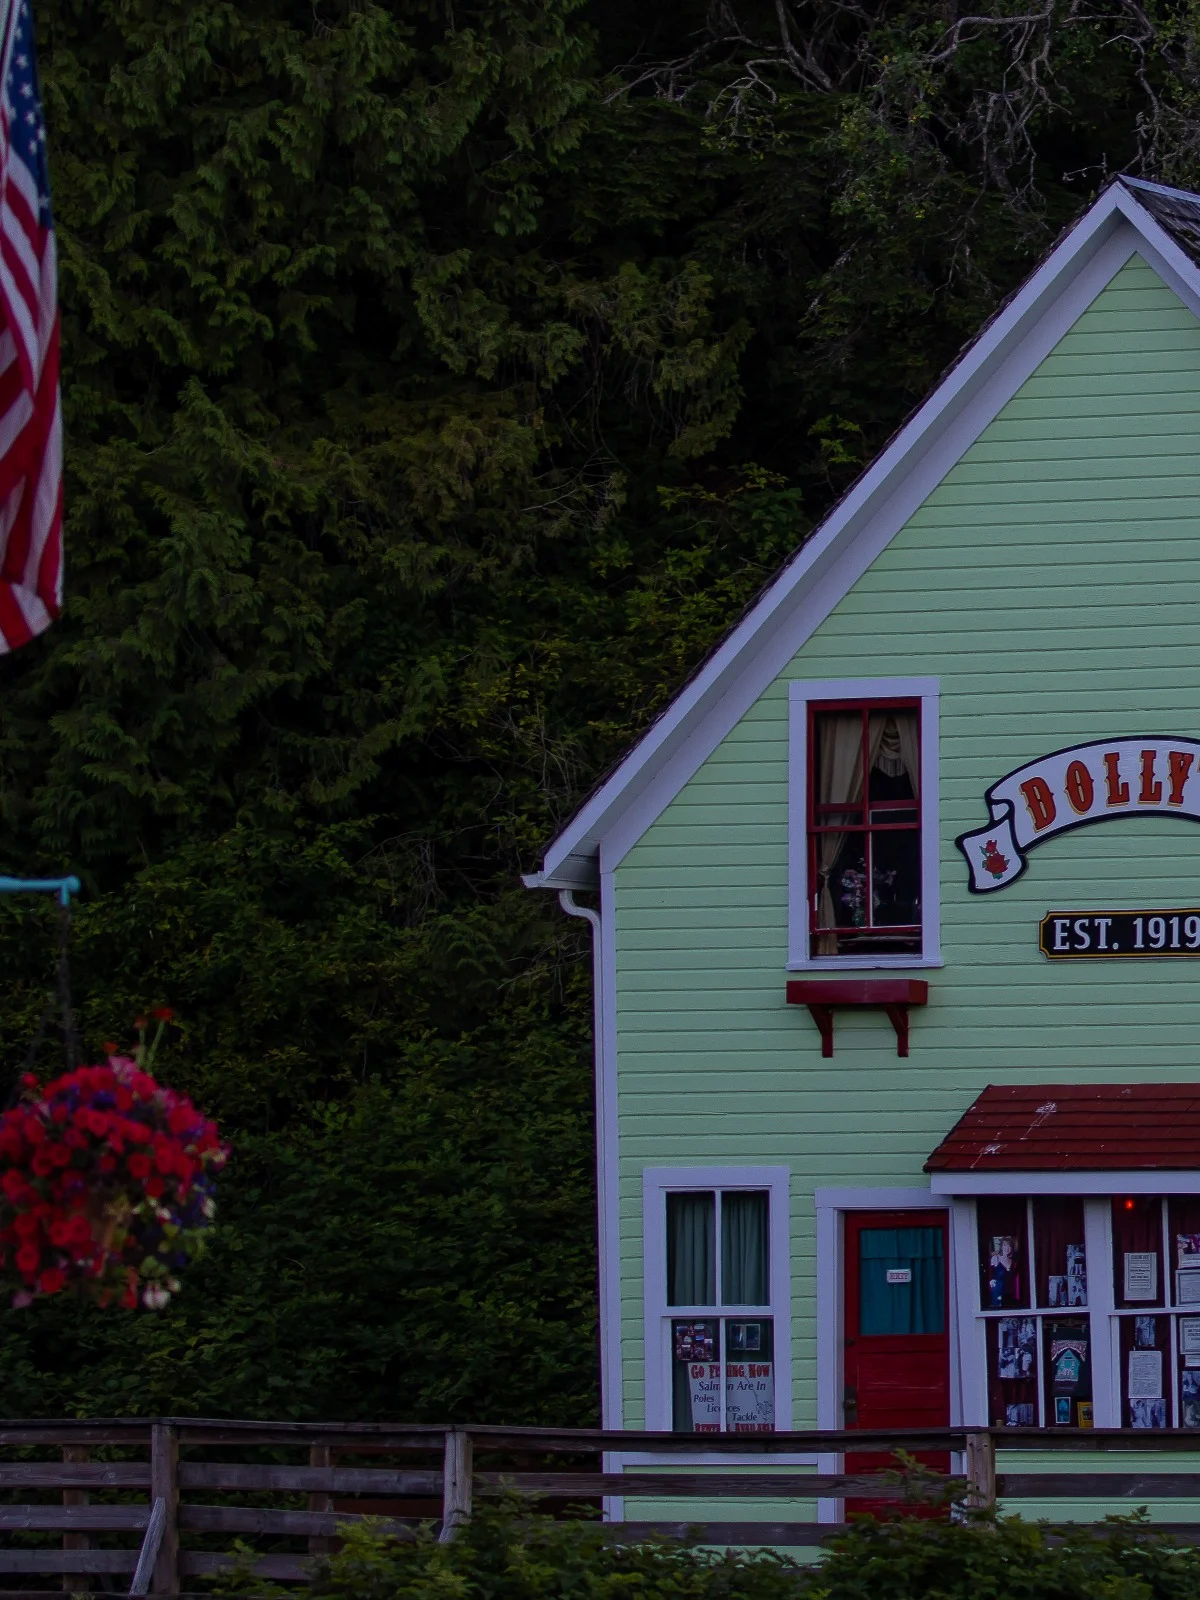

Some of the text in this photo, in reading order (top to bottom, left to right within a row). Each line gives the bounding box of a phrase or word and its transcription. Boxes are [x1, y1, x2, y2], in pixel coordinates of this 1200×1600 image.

[1053, 918, 1119, 950] EST.
[699, 1381, 766, 1391] Salmn Are In
[693, 1394, 715, 1403] Poles
[707, 1404, 740, 1413] Licces
[732, 1412, 757, 1421] Tackle
